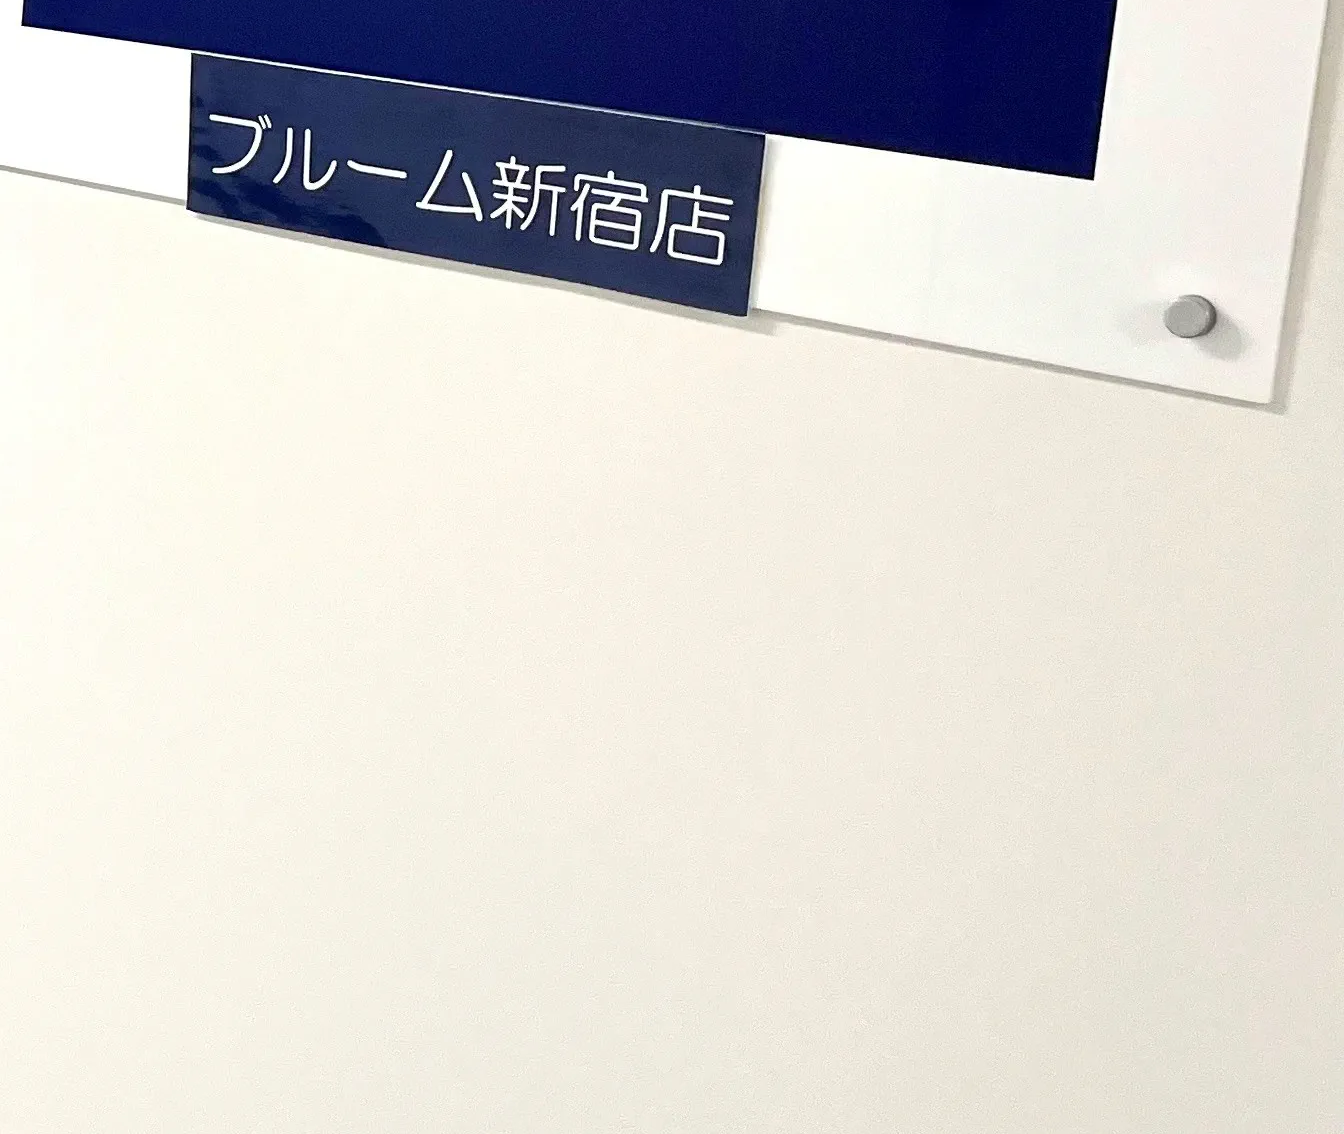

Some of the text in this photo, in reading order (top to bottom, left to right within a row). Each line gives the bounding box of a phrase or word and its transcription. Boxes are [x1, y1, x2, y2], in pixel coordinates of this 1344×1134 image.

[208, 112, 735, 266] ブルーム新宿店
